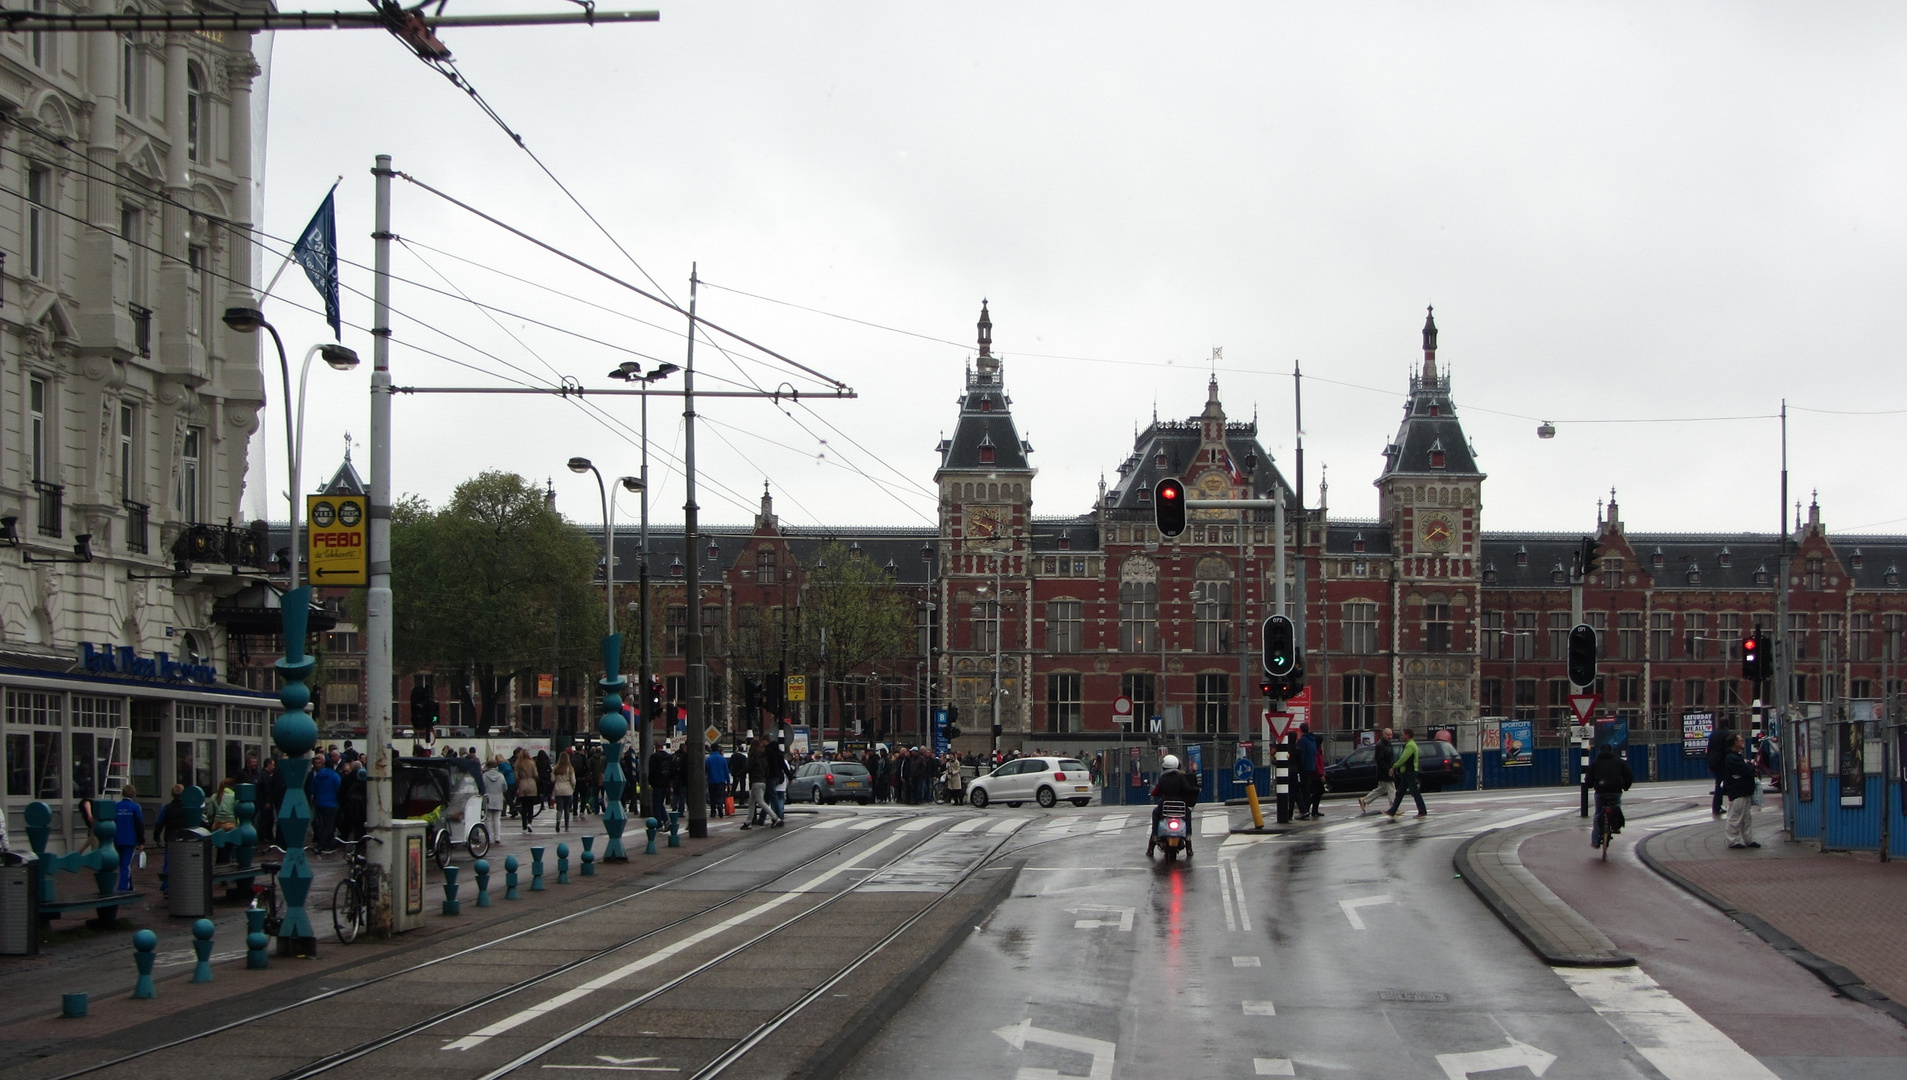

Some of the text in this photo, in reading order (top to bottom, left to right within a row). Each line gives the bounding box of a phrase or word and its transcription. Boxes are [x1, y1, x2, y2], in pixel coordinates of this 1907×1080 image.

[340, 510, 360, 518] FRESH
[313, 532, 362, 548] FEBO
[78, 641, 116, 673] Park
[1150, 719, 1162, 733] M
